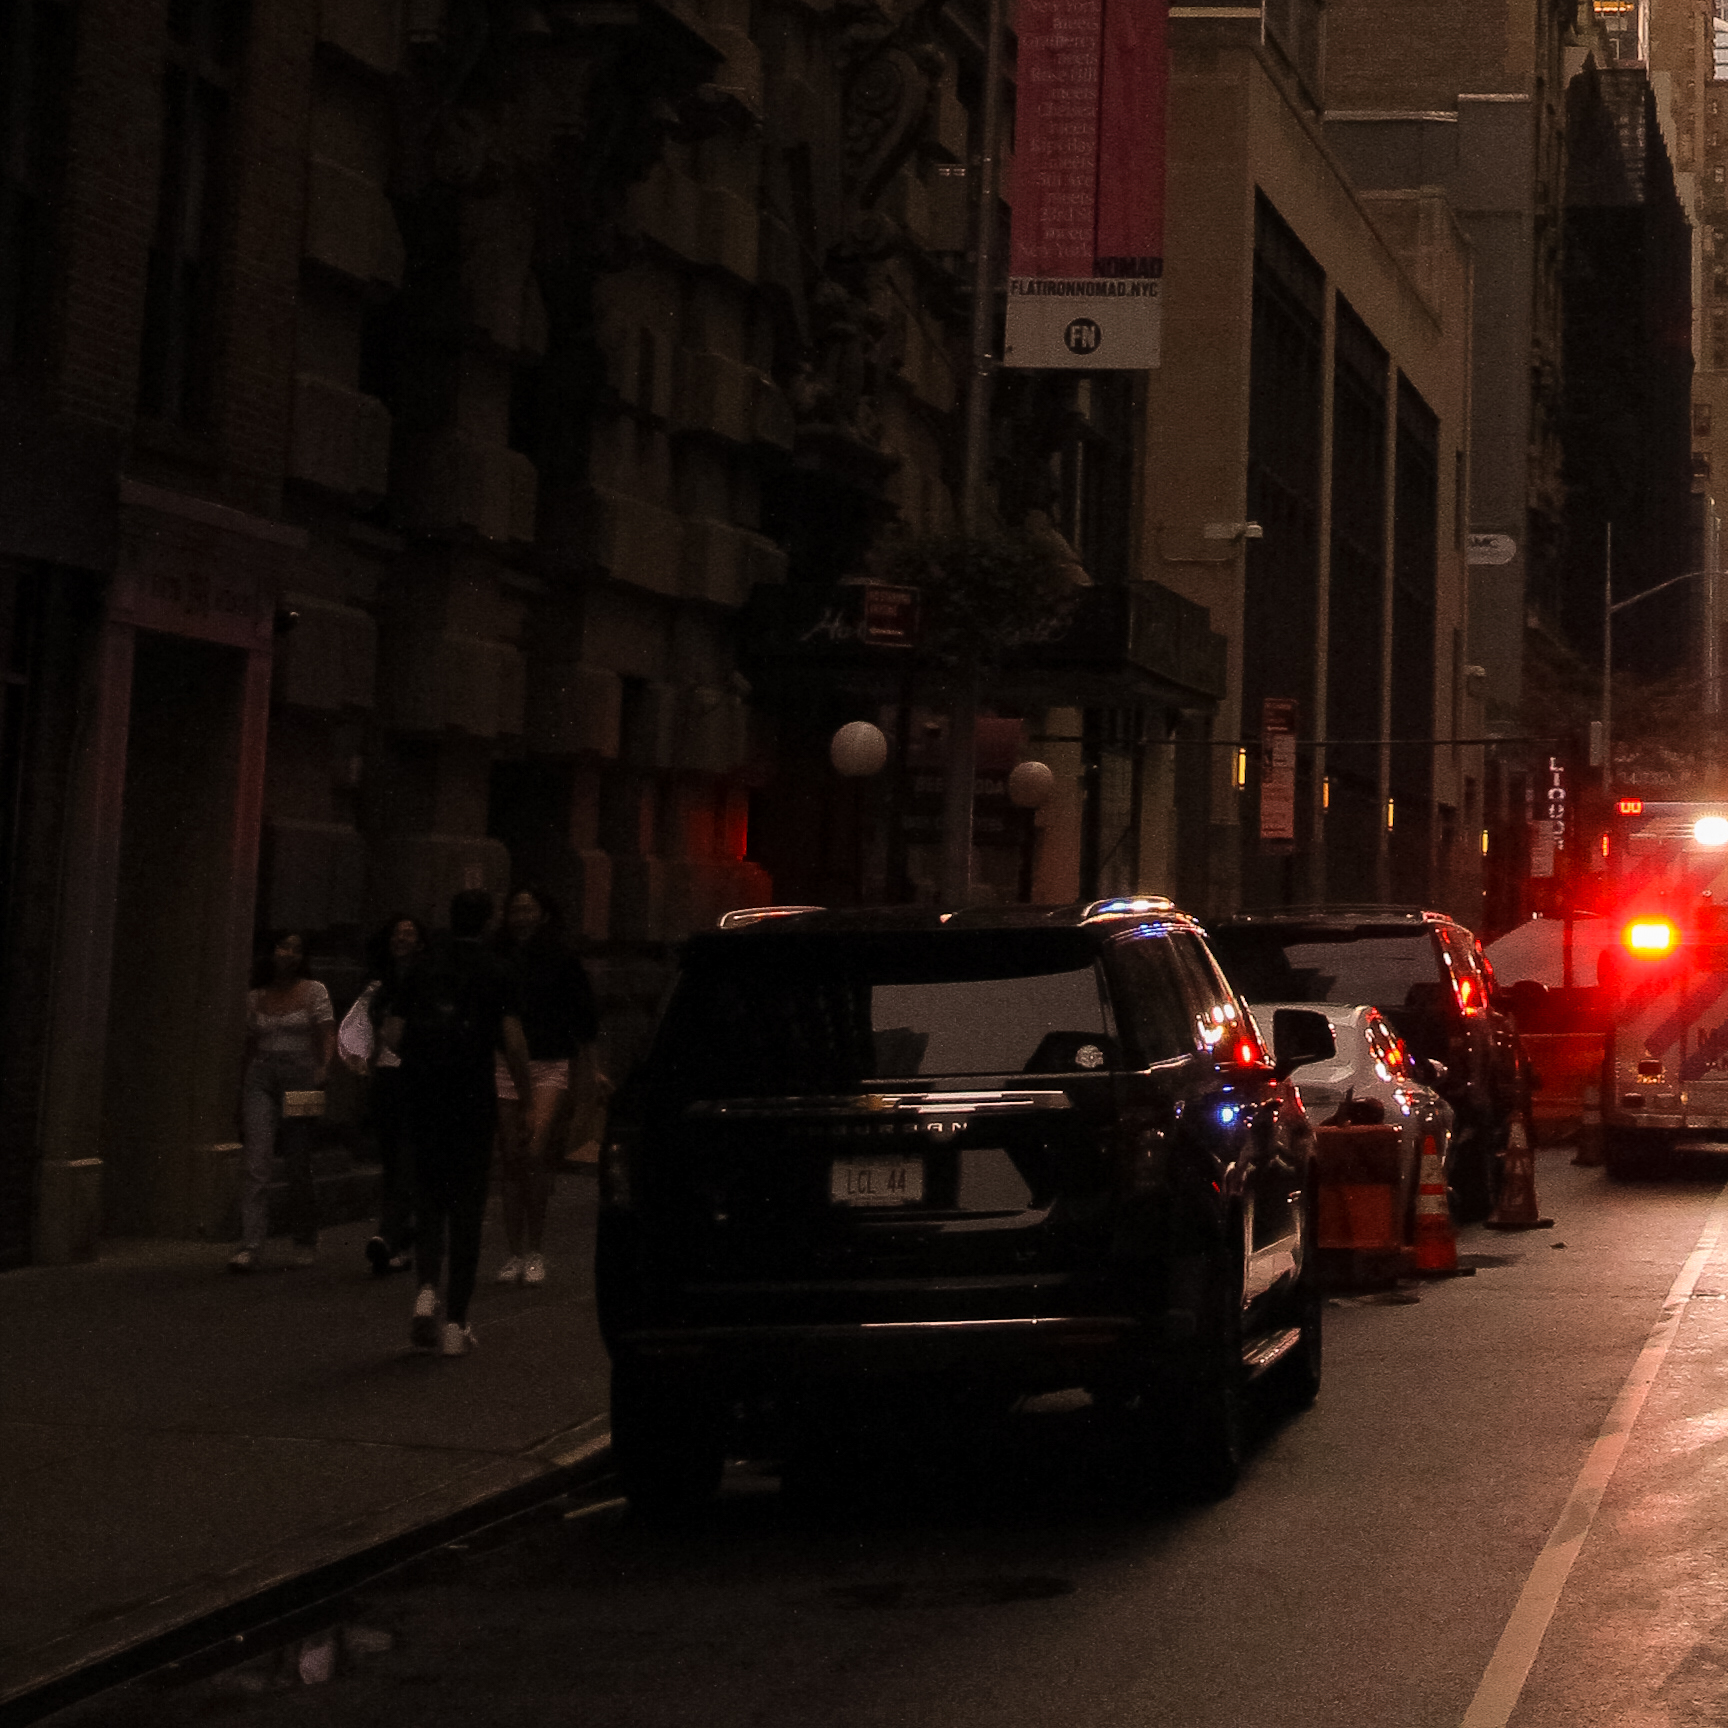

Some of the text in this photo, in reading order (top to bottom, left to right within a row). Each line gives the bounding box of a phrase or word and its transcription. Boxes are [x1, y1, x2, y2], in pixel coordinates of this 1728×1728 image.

[1093, 257, 1163, 277] NOMAD
[1010, 281, 1158, 296] FLATIRONNOMAD.NYC
[1069, 325, 1096, 348] FN
